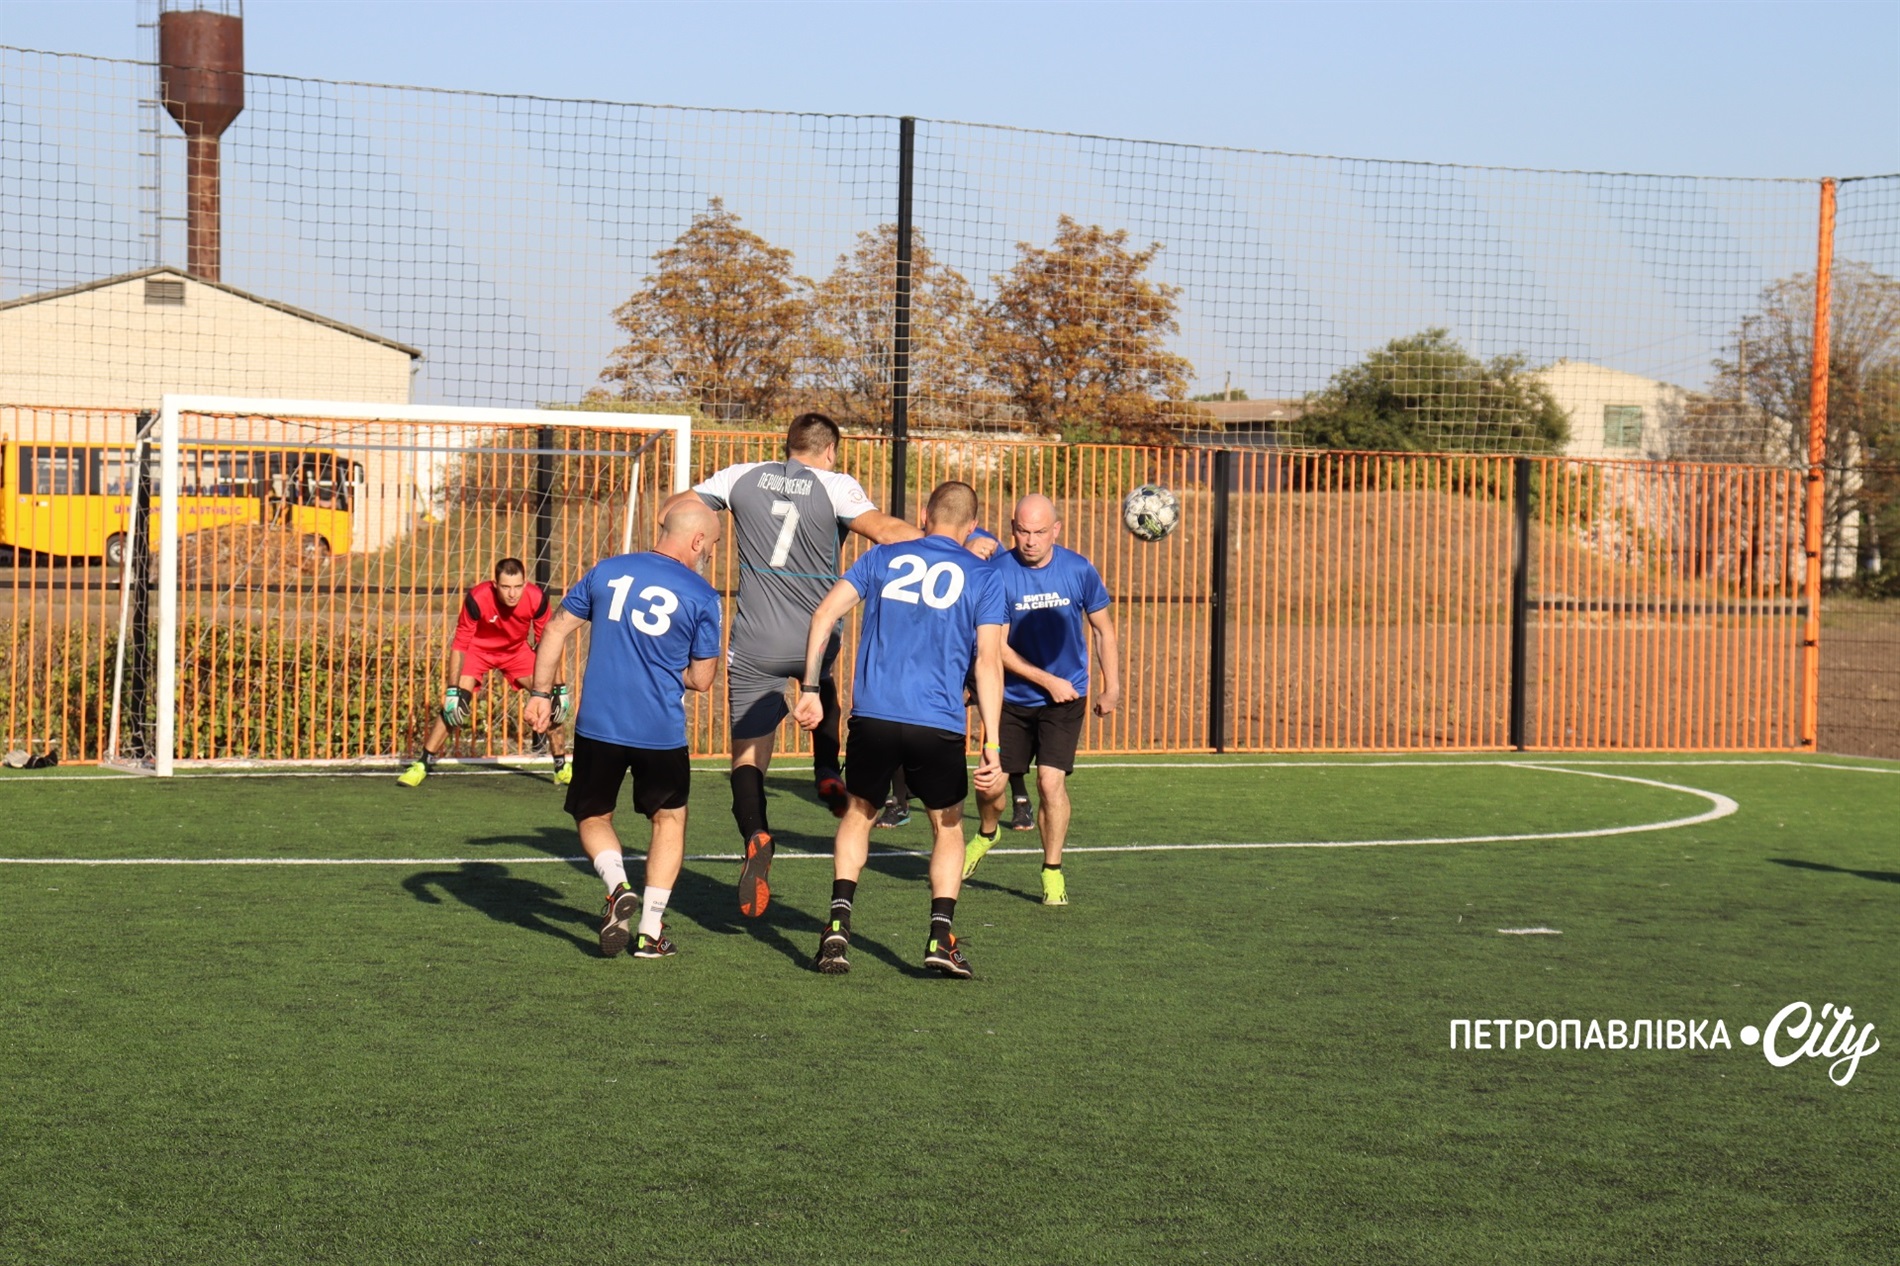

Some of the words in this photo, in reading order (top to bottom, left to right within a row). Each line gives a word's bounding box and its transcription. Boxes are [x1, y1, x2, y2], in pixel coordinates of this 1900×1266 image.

[770, 500, 801, 568] 7
[607, 574, 680, 636] 13
[881, 553, 965, 610] 20
[1015, 602, 1030, 610] ЗА
[1031, 598, 1070, 609] СВІТЛО
[1023, 592, 1060, 602] БИТВА
